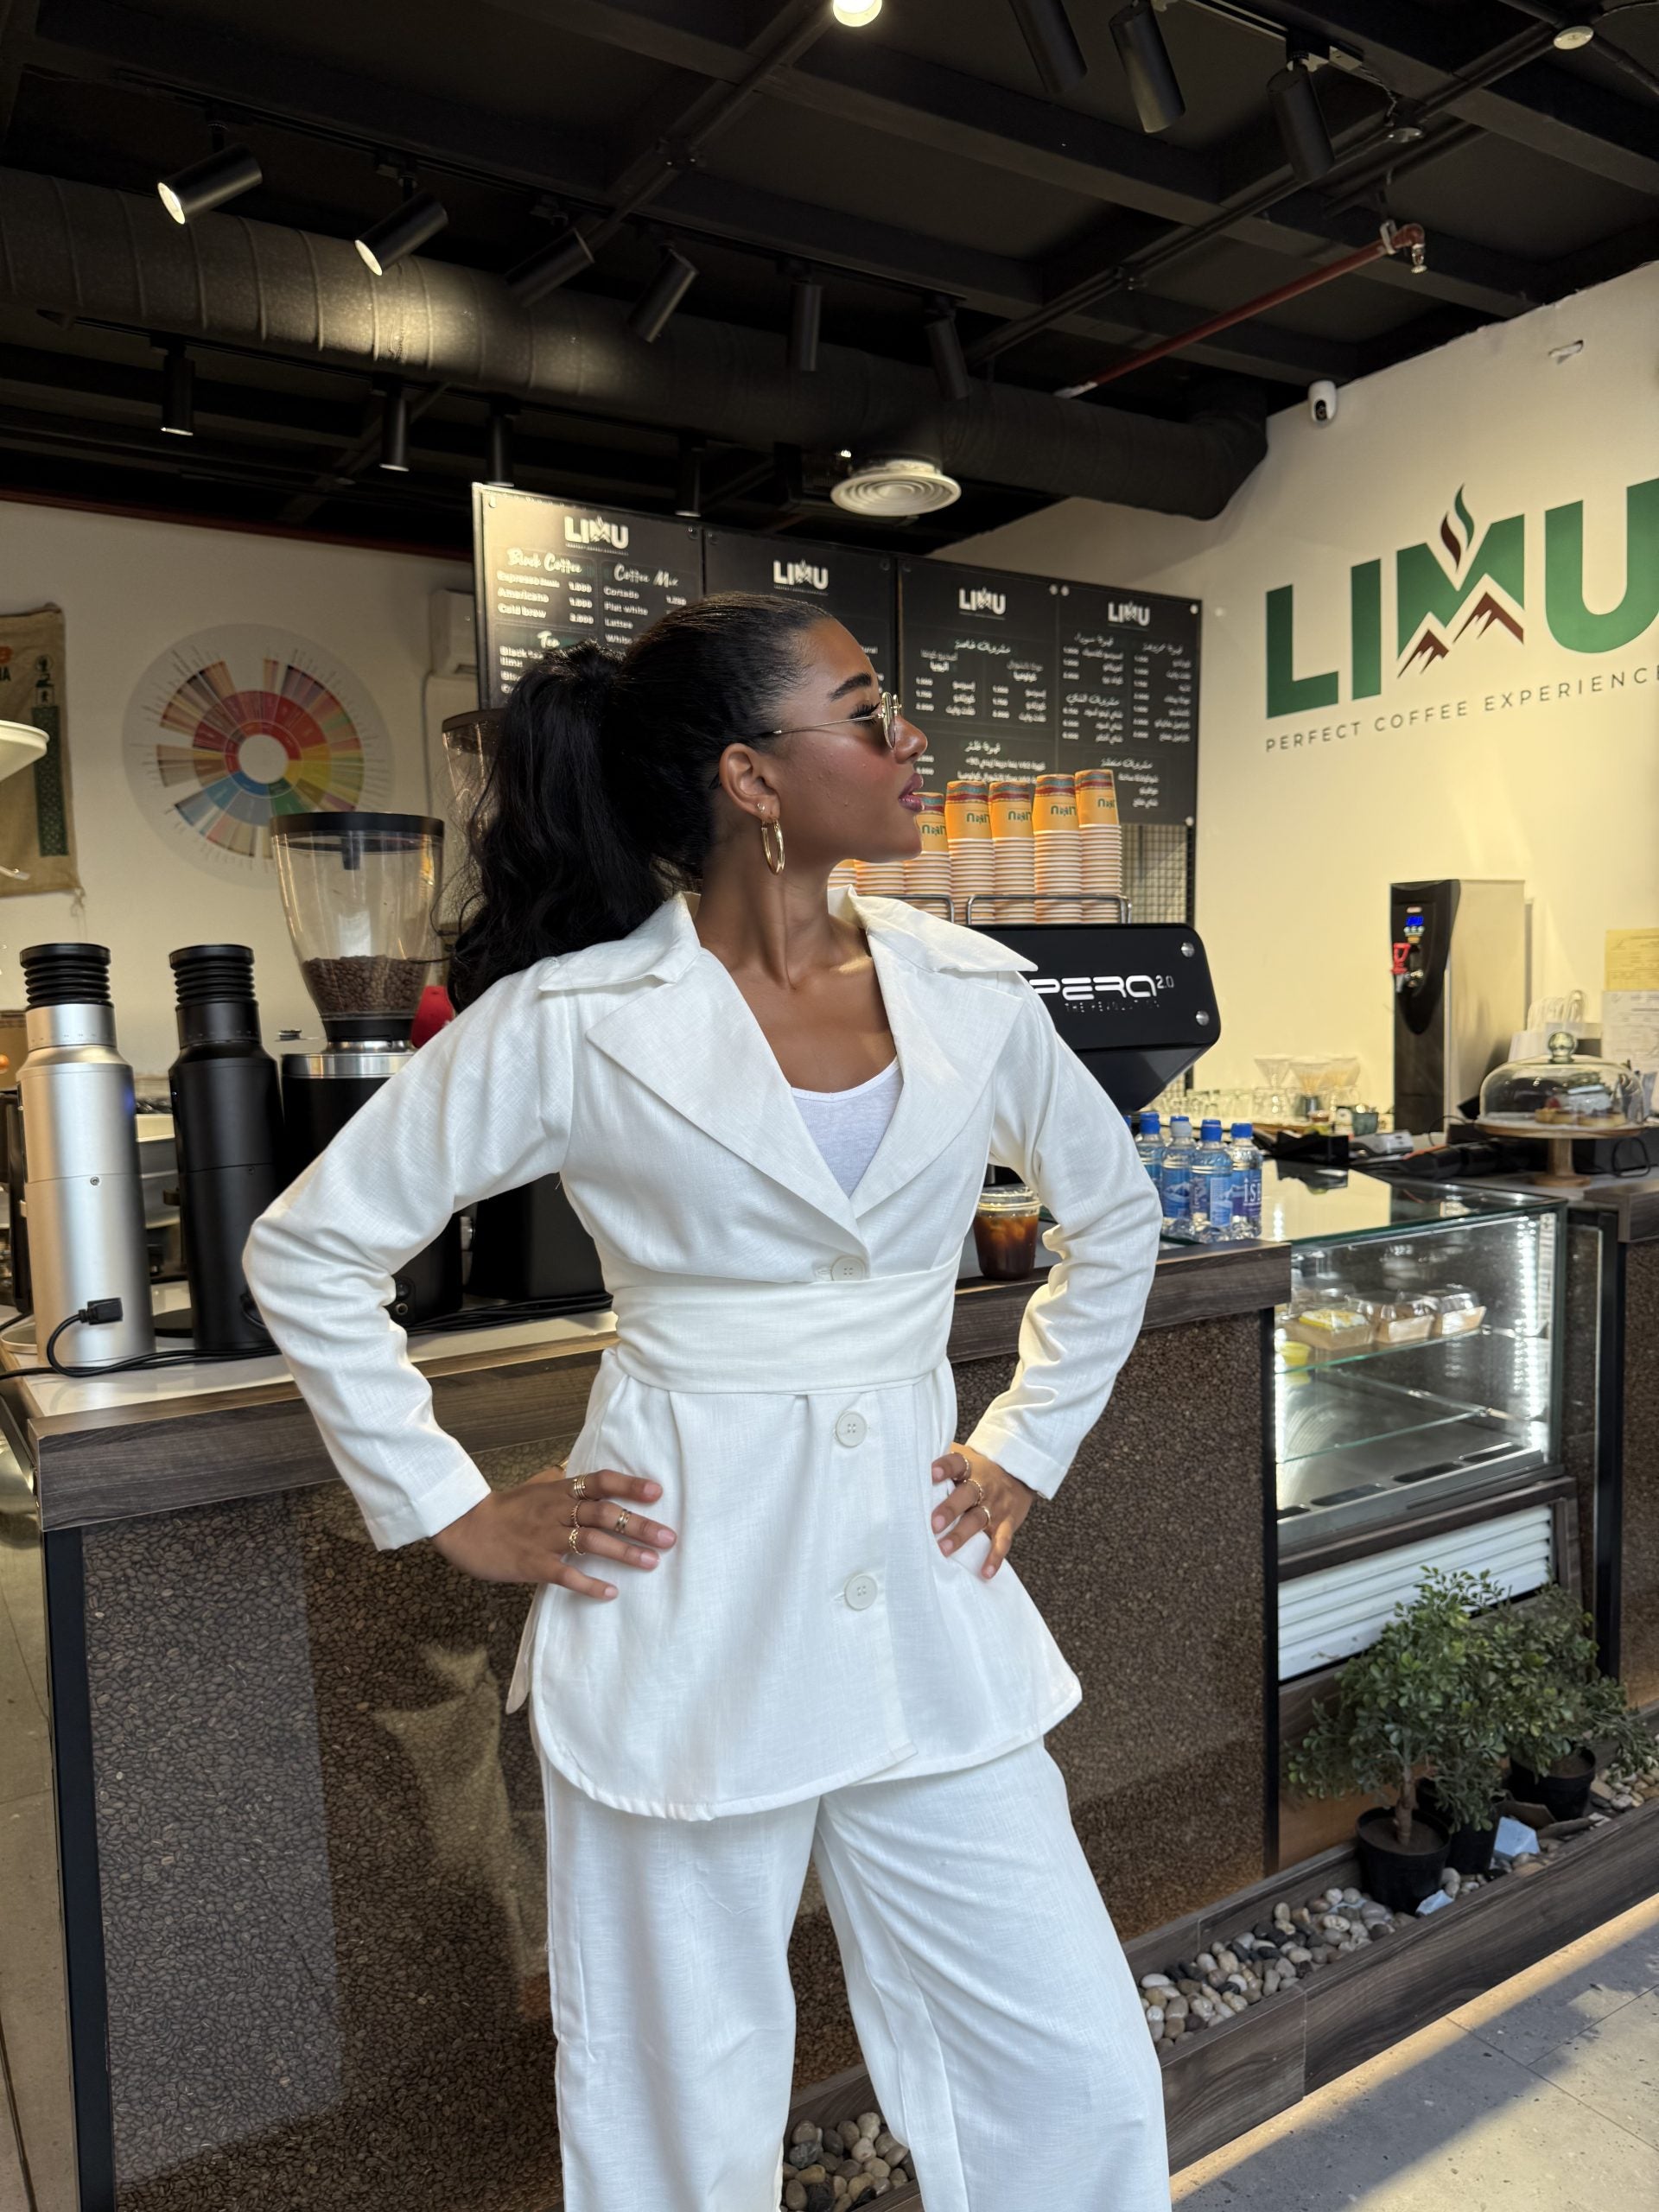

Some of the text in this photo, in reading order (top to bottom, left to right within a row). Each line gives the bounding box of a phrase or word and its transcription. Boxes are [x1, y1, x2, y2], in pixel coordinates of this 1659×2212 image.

[564, 516, 629, 550] LIMU
[507, 548, 542, 569] Black
[543, 552, 582, 574] Coffee
[613, 563, 651, 583] Coffee
[773, 559, 829, 590] LIMU
[497, 588, 550, 602] Americano
[958, 588, 1007, 615] LIMU
[1266, 478, 1659, 719] LIMU
[1108, 601, 1151, 626] LIMU
[537, 631, 560, 648] Tea
[1266, 664, 1659, 753] PERFECT COFFEE EXPERIENC
[1155, 975, 1175, 989] 2.0
